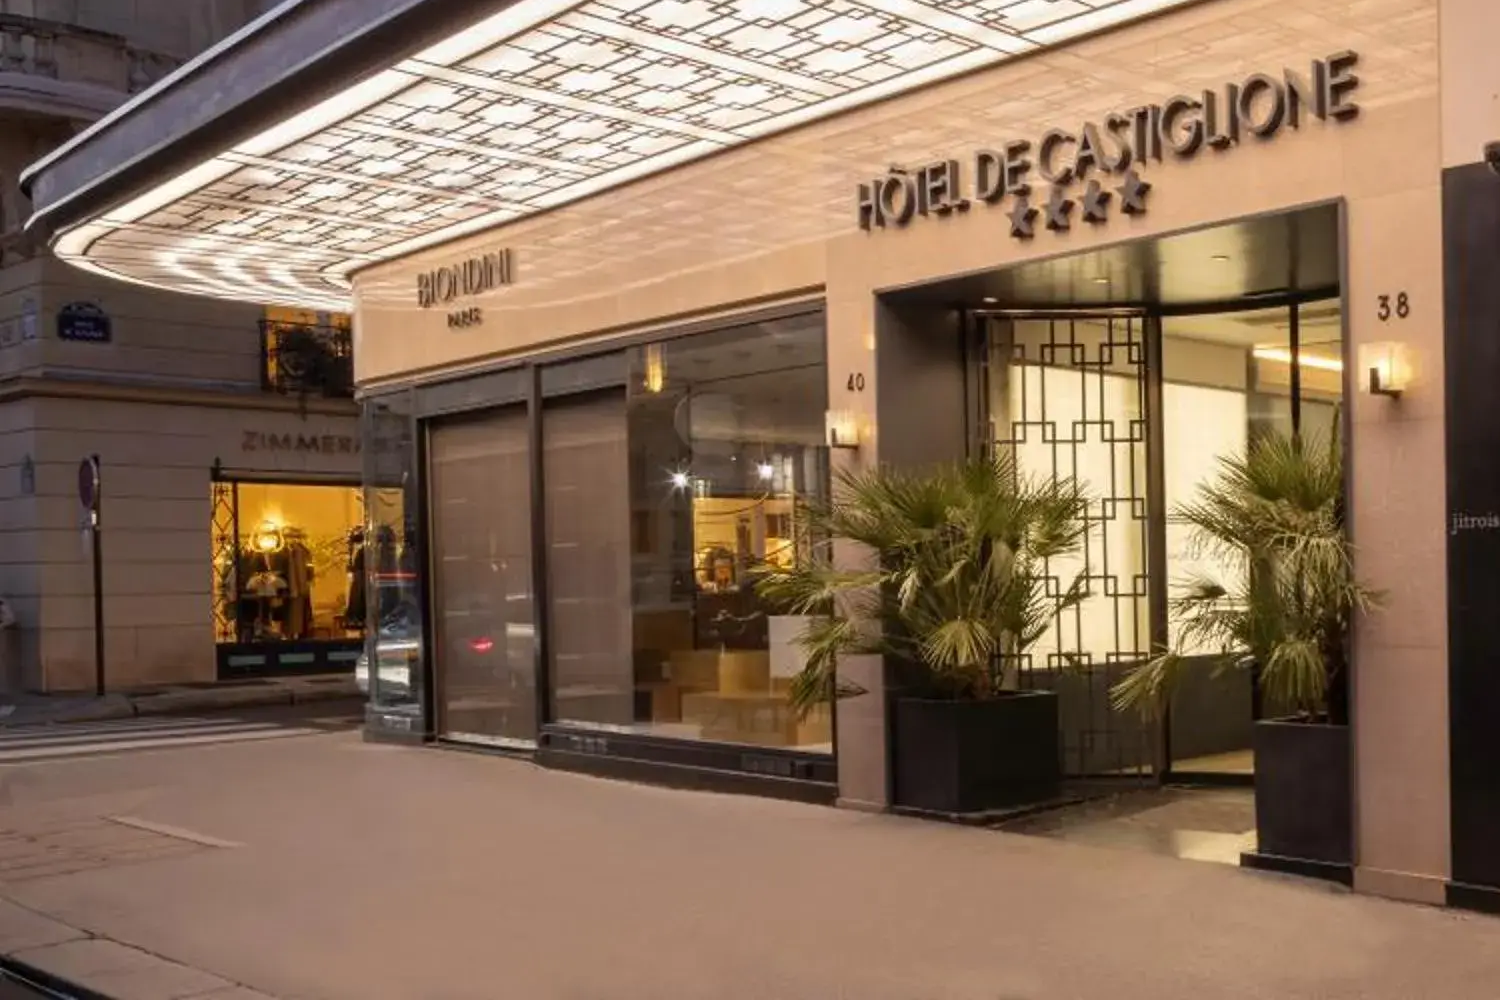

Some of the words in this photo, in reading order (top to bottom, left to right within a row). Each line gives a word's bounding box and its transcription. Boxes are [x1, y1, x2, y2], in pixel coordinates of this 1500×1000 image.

[857, 156, 970, 232] HÔTEL
[974, 138, 1033, 201] DE
[1038, 48, 1361, 185] CASTIGLIONE
[417, 247, 513, 308] BIONDINI
[447, 307, 483, 329] PARIS
[1377, 291, 1410, 321] 38
[847, 372, 865, 392] 40
[241, 430, 361, 456] ZIMMER
